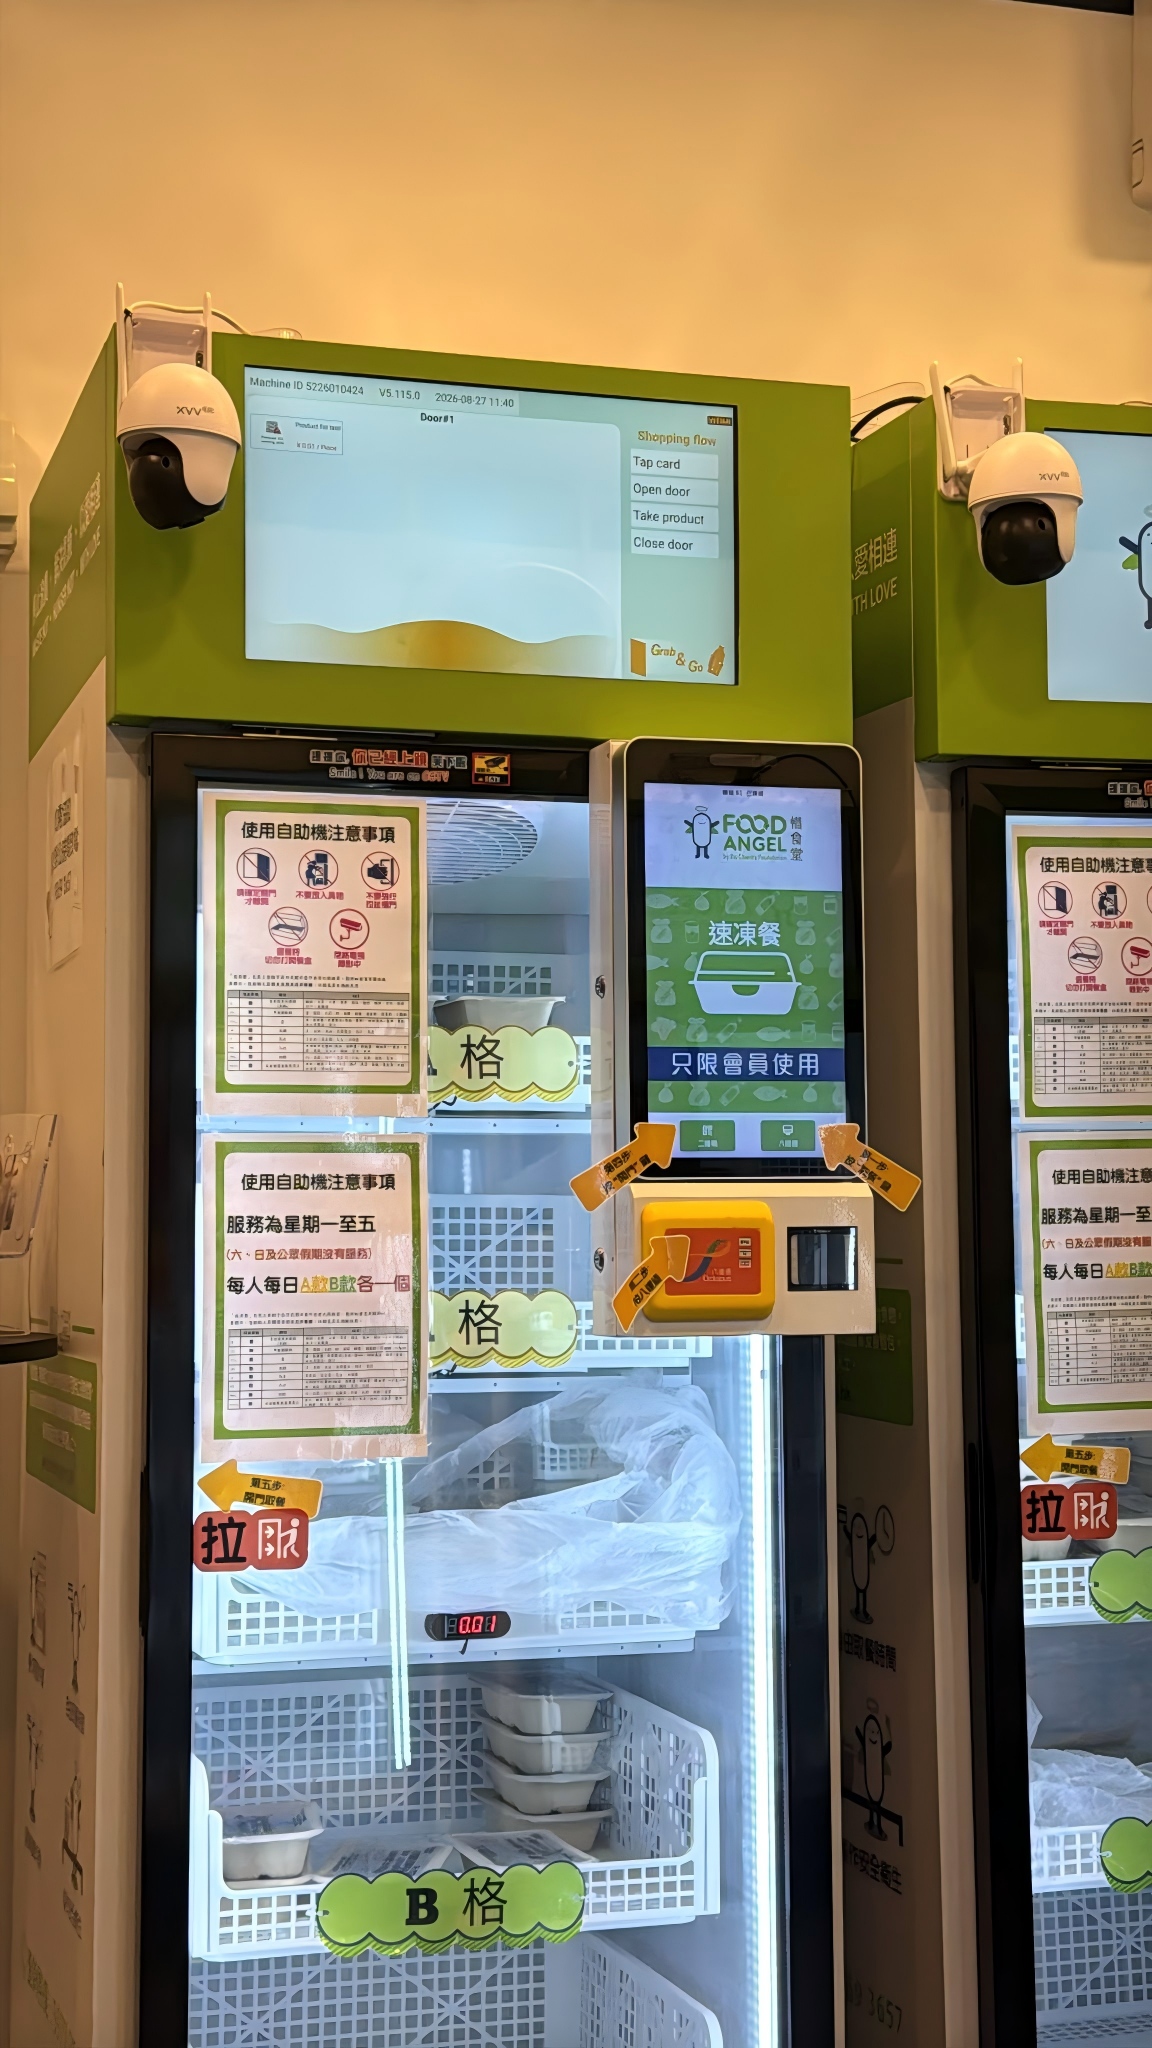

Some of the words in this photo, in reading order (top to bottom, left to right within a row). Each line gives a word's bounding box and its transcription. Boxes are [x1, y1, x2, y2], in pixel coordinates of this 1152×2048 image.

[249, 376, 292, 390] Machine
[293, 380, 304, 390] ID
[305, 381, 365, 396] 5226010424
[378, 387, 421, 401] V5.115.0
[434, 392, 487, 405] 2026-08-27
[489, 397, 515, 408] 11:40
[420, 412, 455, 424] Door#1
[637, 430, 690, 447] Shopping
[693, 433, 718, 446] flow
[633, 455, 654, 469] Tap
[656, 458, 681, 470] card
[633, 482, 662, 496] Open
[665, 484, 691, 497] door
[633, 509, 660, 523] Take
[662, 512, 704, 525] product
[633, 536, 665, 550] Close
[667, 538, 694, 551] door
[852, 589, 868, 616] TH
[870, 576, 898, 608] LOVE
[650, 643, 677, 657] Grab
[675, 651, 686, 667] &
[688, 659, 703, 673] Go
[241, 821, 396, 844] 使用自助機注意事項
[722, 813, 788, 835] FOOD
[723, 835, 788, 853] ANGEL
[708, 920, 781, 947] 速凍餐
[459, 1033, 504, 1081] 格
[671, 1052, 820, 1077] 只限會員使用
[241, 1173, 396, 1191] 使用自助機注意事項
[1051, 1167, 1152, 1185] 使用自助機注意
[226, 1214, 377, 1234] 服務為星期一至五
[1041, 1205, 1152, 1225] 服務為星期一至
[1042, 1262, 1152, 1281] 每人每日A款B款
[226, 1274, 410, 1295] 每人每日A款B款各一個
[457, 1298, 503, 1346] 格
[1026, 1489, 1067, 1534] 拉
[201, 1516, 247, 1565] 拉
[458, 1614, 497, 1634] 0.01
[405, 1887, 439, 1926] B
[462, 1877, 508, 1927] 格
